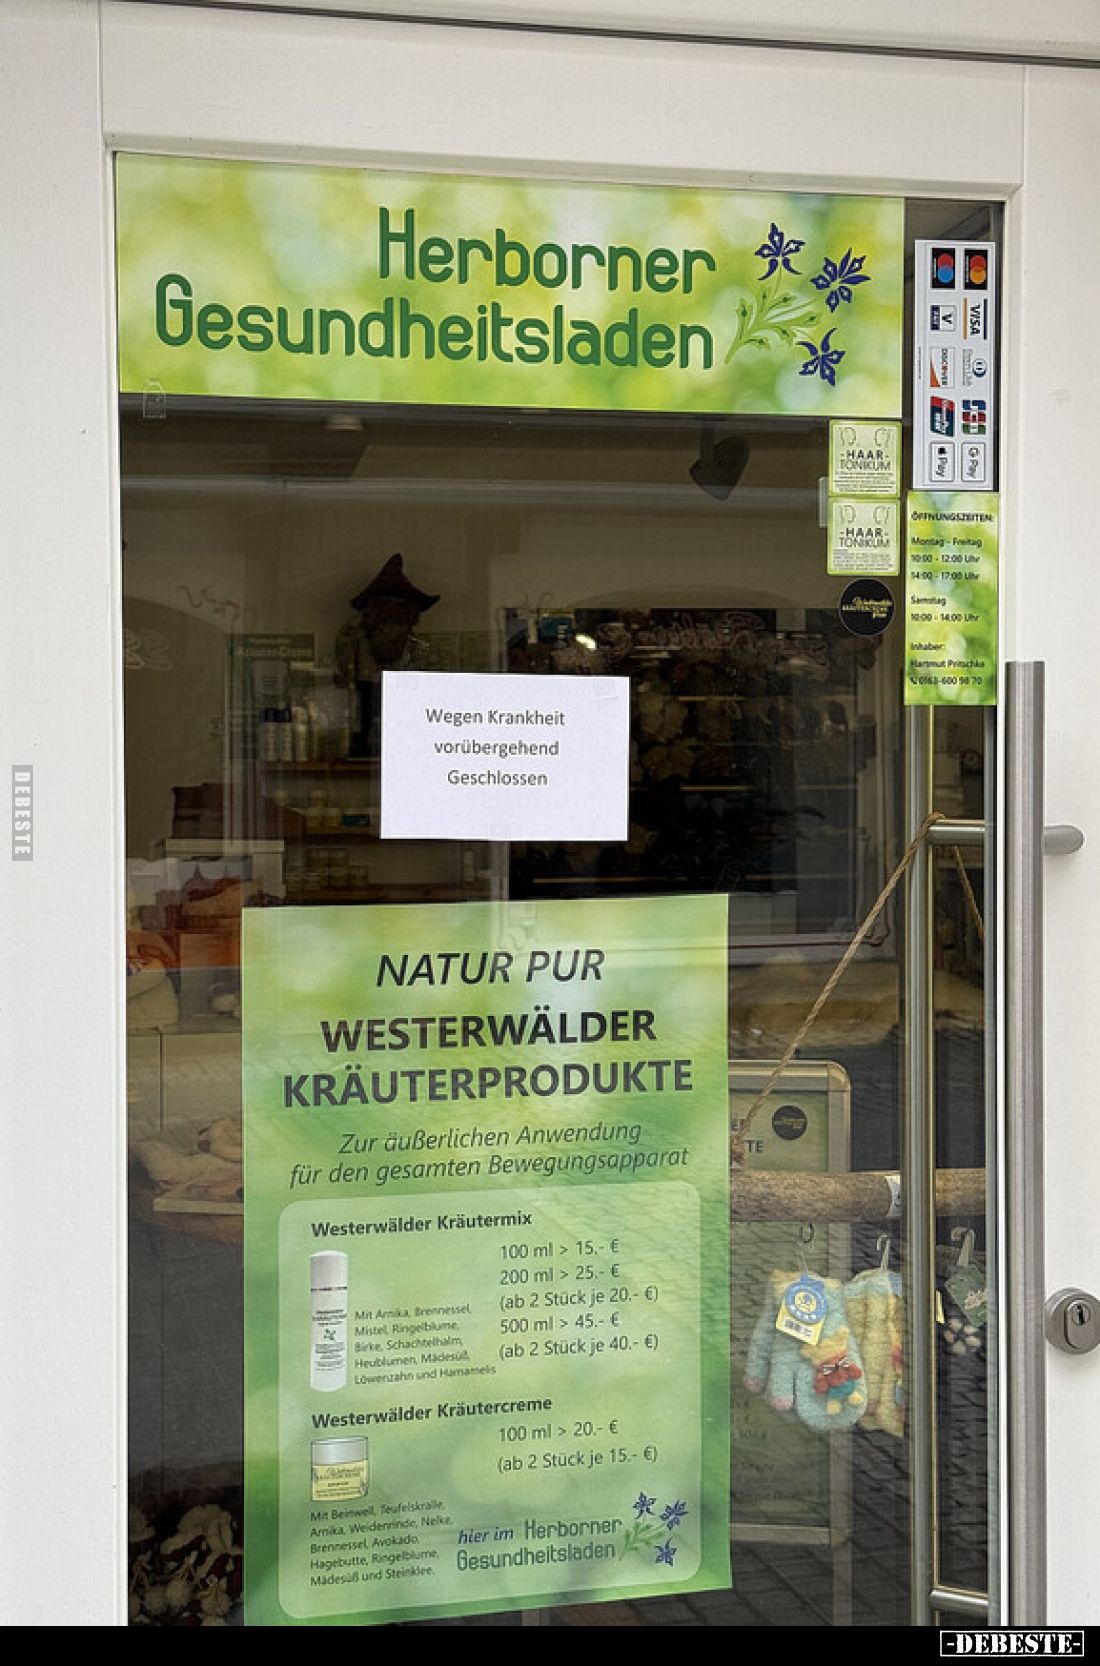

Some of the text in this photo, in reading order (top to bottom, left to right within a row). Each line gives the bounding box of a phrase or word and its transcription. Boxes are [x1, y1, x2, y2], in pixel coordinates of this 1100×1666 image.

[379, 207, 717, 293] Herborner
[155, 273, 714, 370] Gesundheitsladen
[970, 304, 981, 336] VISA
[839, 460, 891, 471] TONIKUM
[936, 457, 948, 478] Pay
[967, 459, 979, 479] Pay
[839, 537, 890, 548] TONIKUM
[911, 537, 944, 548] Montag
[953, 537, 982, 548] Freitag
[911, 554, 933, 563] 10:00
[941, 554, 963, 563] 12:00
[964, 554, 980, 563] Uhr
[911, 571, 933, 580] 14:00
[964, 571, 980, 580] Uhr
[911, 594, 946, 606] Samstag
[911, 613, 933, 622] 10:00
[964, 613, 980, 622] Uhr
[911, 659, 946, 668] Hartmut
[425, 708, 565, 727] Wegen Krankheit
[434, 739, 560, 759] vorübergehend
[447, 769, 548, 786] Geschlossen
[376, 949, 606, 987] NATUR PUR
[320, 1005, 656, 1053] WESTERWÄLDER
[283, 1059, 693, 1109] KRÄUTERPRODUKTE
[338, 1121, 642, 1154] Zur äußerlichen Anwendung
[289, 1147, 689, 1190] für den gesamten Bewegungsapparat
[311, 1210, 533, 1238] Westerwälder Kräutermix
[500, 1244, 529, 1260] 100
[533, 1242, 553, 1257] ml
[610, 1238, 620, 1253] €
[500, 1269, 529, 1285] 200
[533, 1267, 553, 1282] ml
[610, 1263, 620, 1277] €
[500, 1294, 525, 1312] (ab
[529, 1292, 539, 1308] 2
[544, 1290, 586, 1307] Stück
[588, 1289, 605, 1308] je
[643, 1285, 659, 1302] €)
[354, 1310, 373, 1320] Mit
[500, 1318, 529, 1334] 500
[533, 1316, 553, 1331] ml
[610, 1311, 620, 1327] €
[499, 1343, 525, 1361] (ab
[529, 1341, 539, 1356] 2
[544, 1338, 586, 1356] Stück
[588, 1338, 605, 1357] je
[643, 1333, 659, 1350] €)
[354, 1364, 497, 1385] Löwenzahn und Hamamelis
[311, 1397, 553, 1430] Westerwälder Kräutercreme
[499, 1426, 527, 1442] 100
[532, 1423, 552, 1440] ml
[609, 1419, 619, 1434] €
[497, 1456, 523, 1474] (ab
[528, 1453, 538, 1469] 2
[543, 1450, 585, 1468] Stück
[587, 1450, 604, 1469] je
[643, 1445, 659, 1463] €)
[310, 1511, 328, 1521] Mit
[457, 1518, 623, 1545] hier im Herborner
[457, 1541, 617, 1572] Gesundheitsladen
[362, 1570, 382, 1582] und
